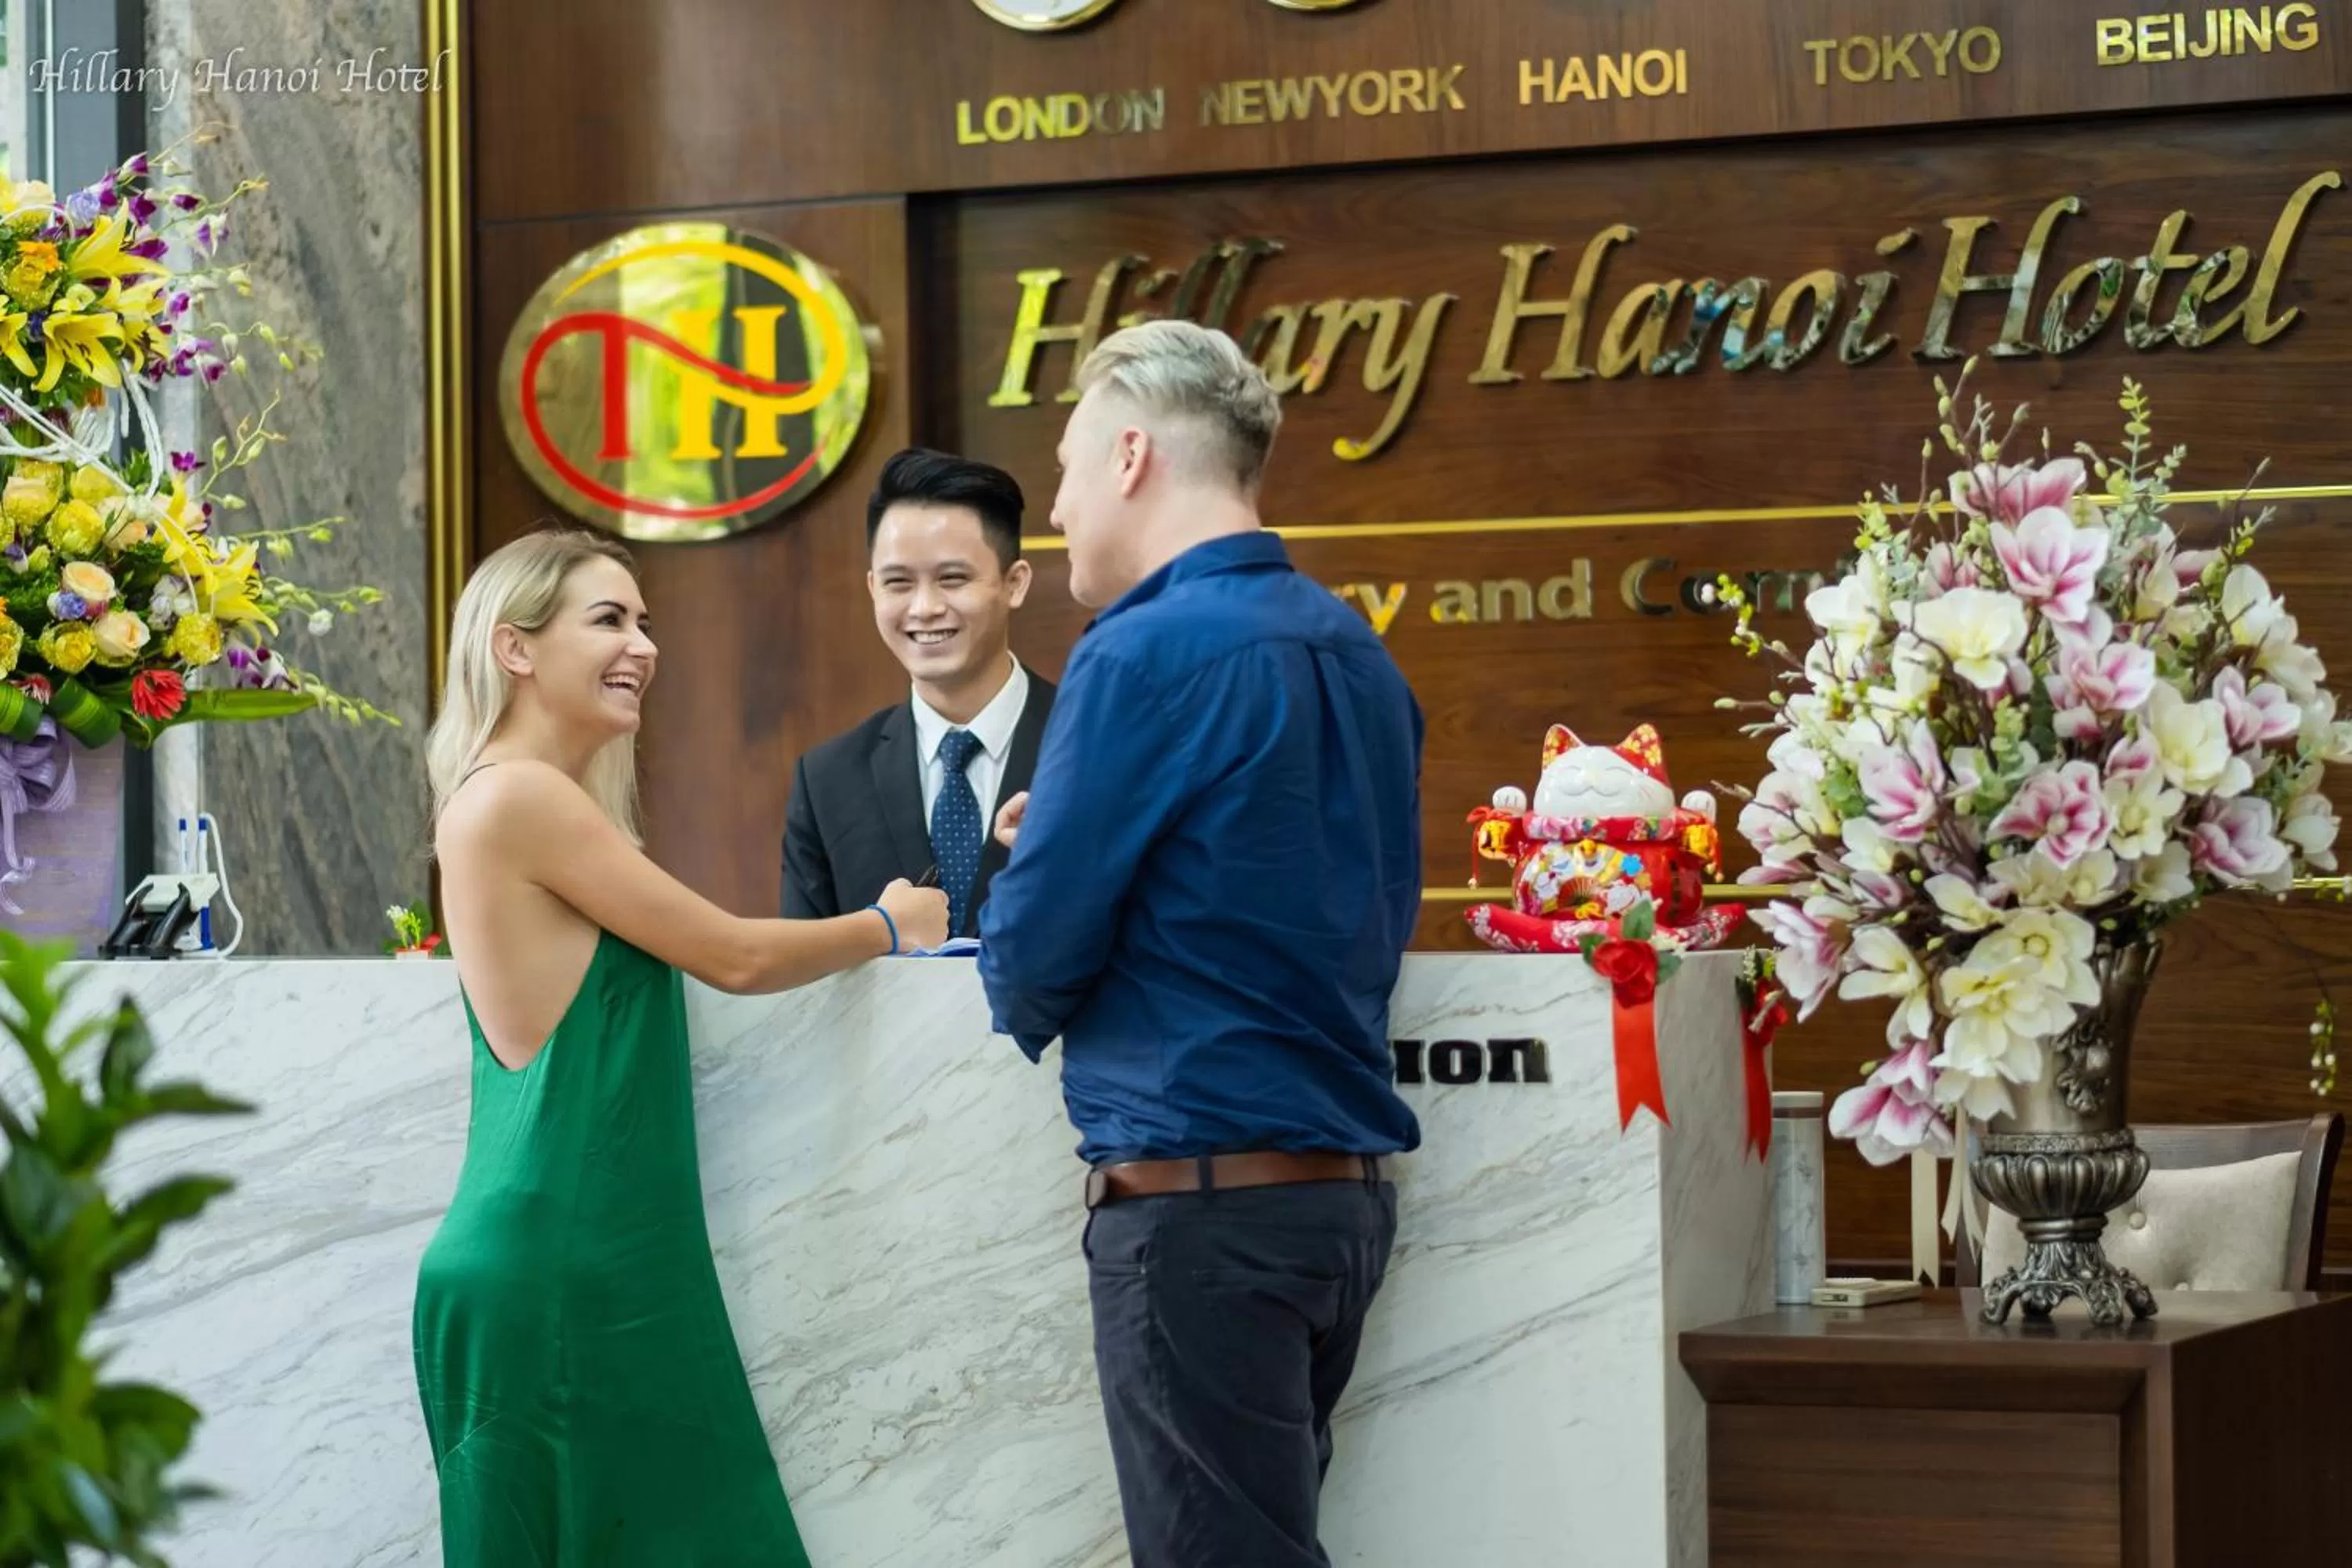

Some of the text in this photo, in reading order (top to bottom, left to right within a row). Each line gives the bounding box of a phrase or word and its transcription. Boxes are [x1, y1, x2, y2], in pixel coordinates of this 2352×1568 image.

[956, 2, 2321, 146] LONDON NEWYORK HANOI TOKYO BEIJING
[1467, 223, 1921, 384] Hanoi
[1909, 169, 2343, 361] Hotel
[1429, 557, 1593, 625] and
